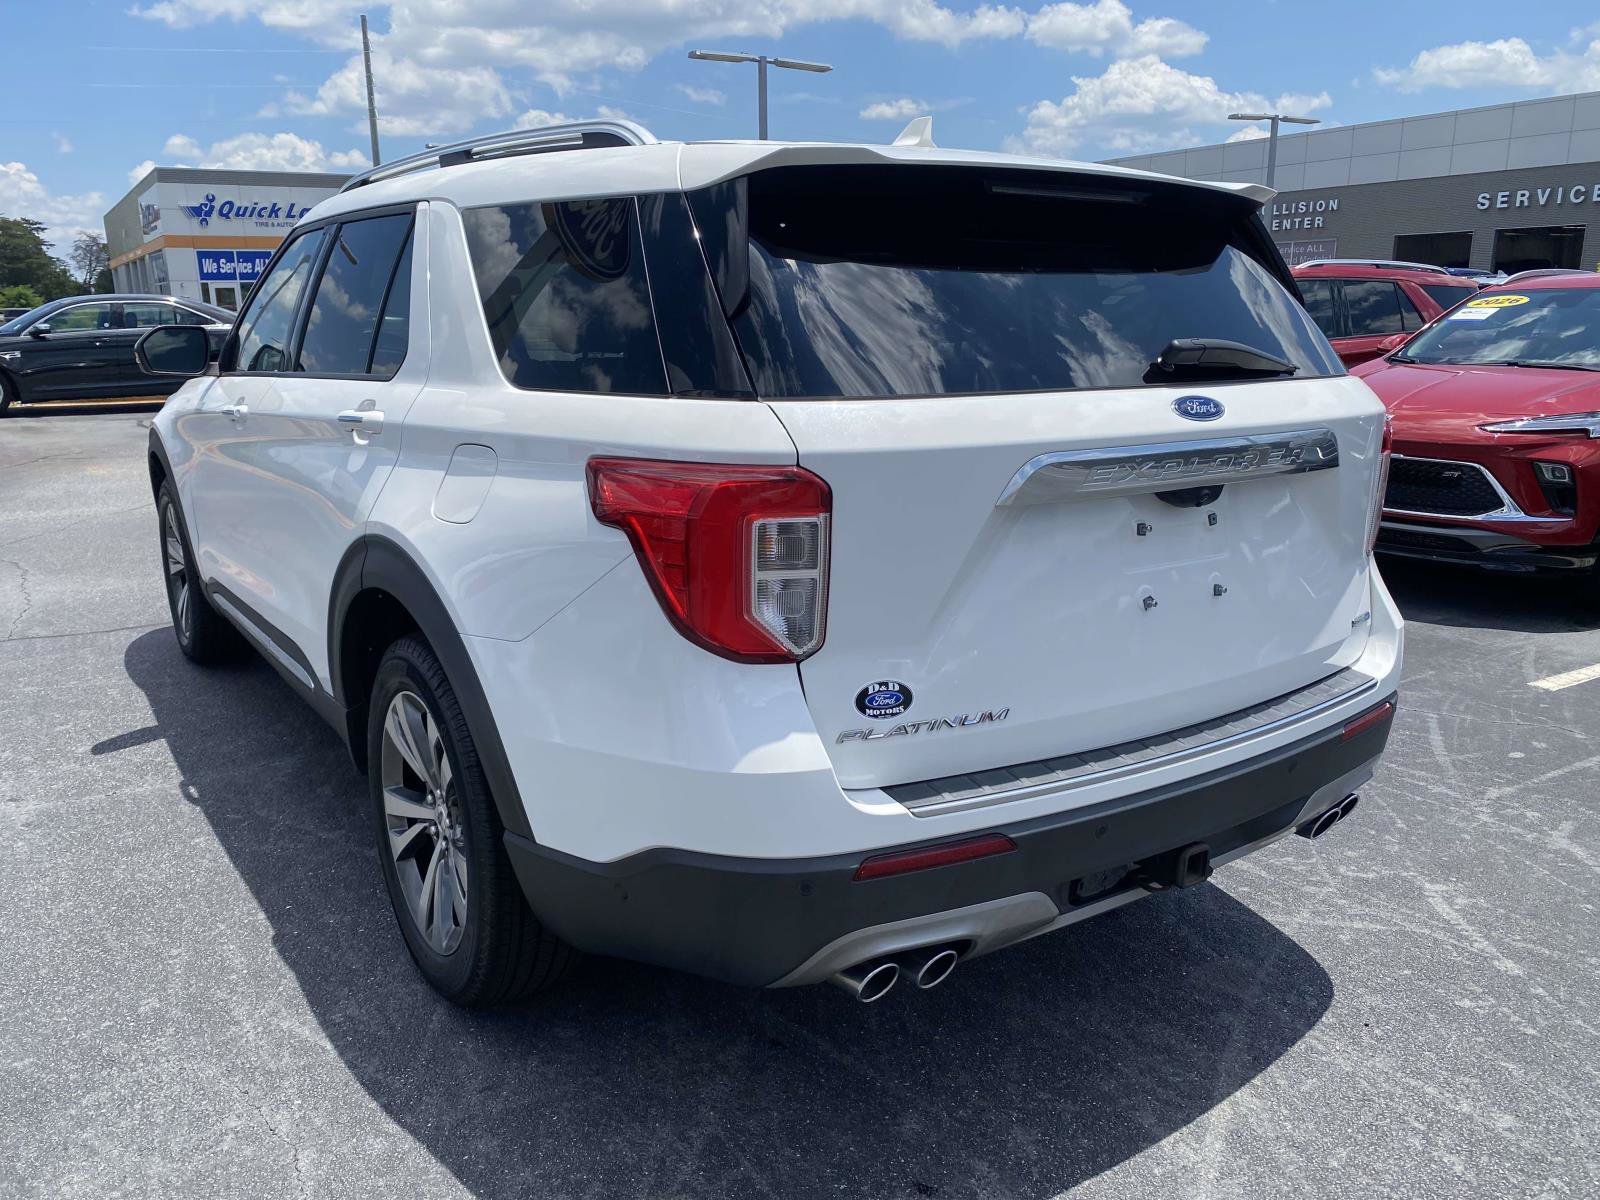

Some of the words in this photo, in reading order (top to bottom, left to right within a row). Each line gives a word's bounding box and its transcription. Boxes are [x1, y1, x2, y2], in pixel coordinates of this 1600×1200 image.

[1476, 183, 1600, 210] SERVICE
[218, 200, 282, 220] Quick
[1261, 199, 1339, 215] LLISION
[1272, 216, 1324, 231] ENTER
[1307, 244, 1325, 253] ALL
[202, 258, 217, 273] We
[219, 258, 253, 273] Service
[1471, 297, 1524, 306] 2026
[1186, 399, 1217, 413] Ford
[1083, 447, 1306, 487] EXPLORER
[867, 682, 900, 695] D&D
[872, 694, 897, 706] Ford
[865, 705, 905, 717] MOTORS
[835, 707, 1010, 744] PLATINUM
